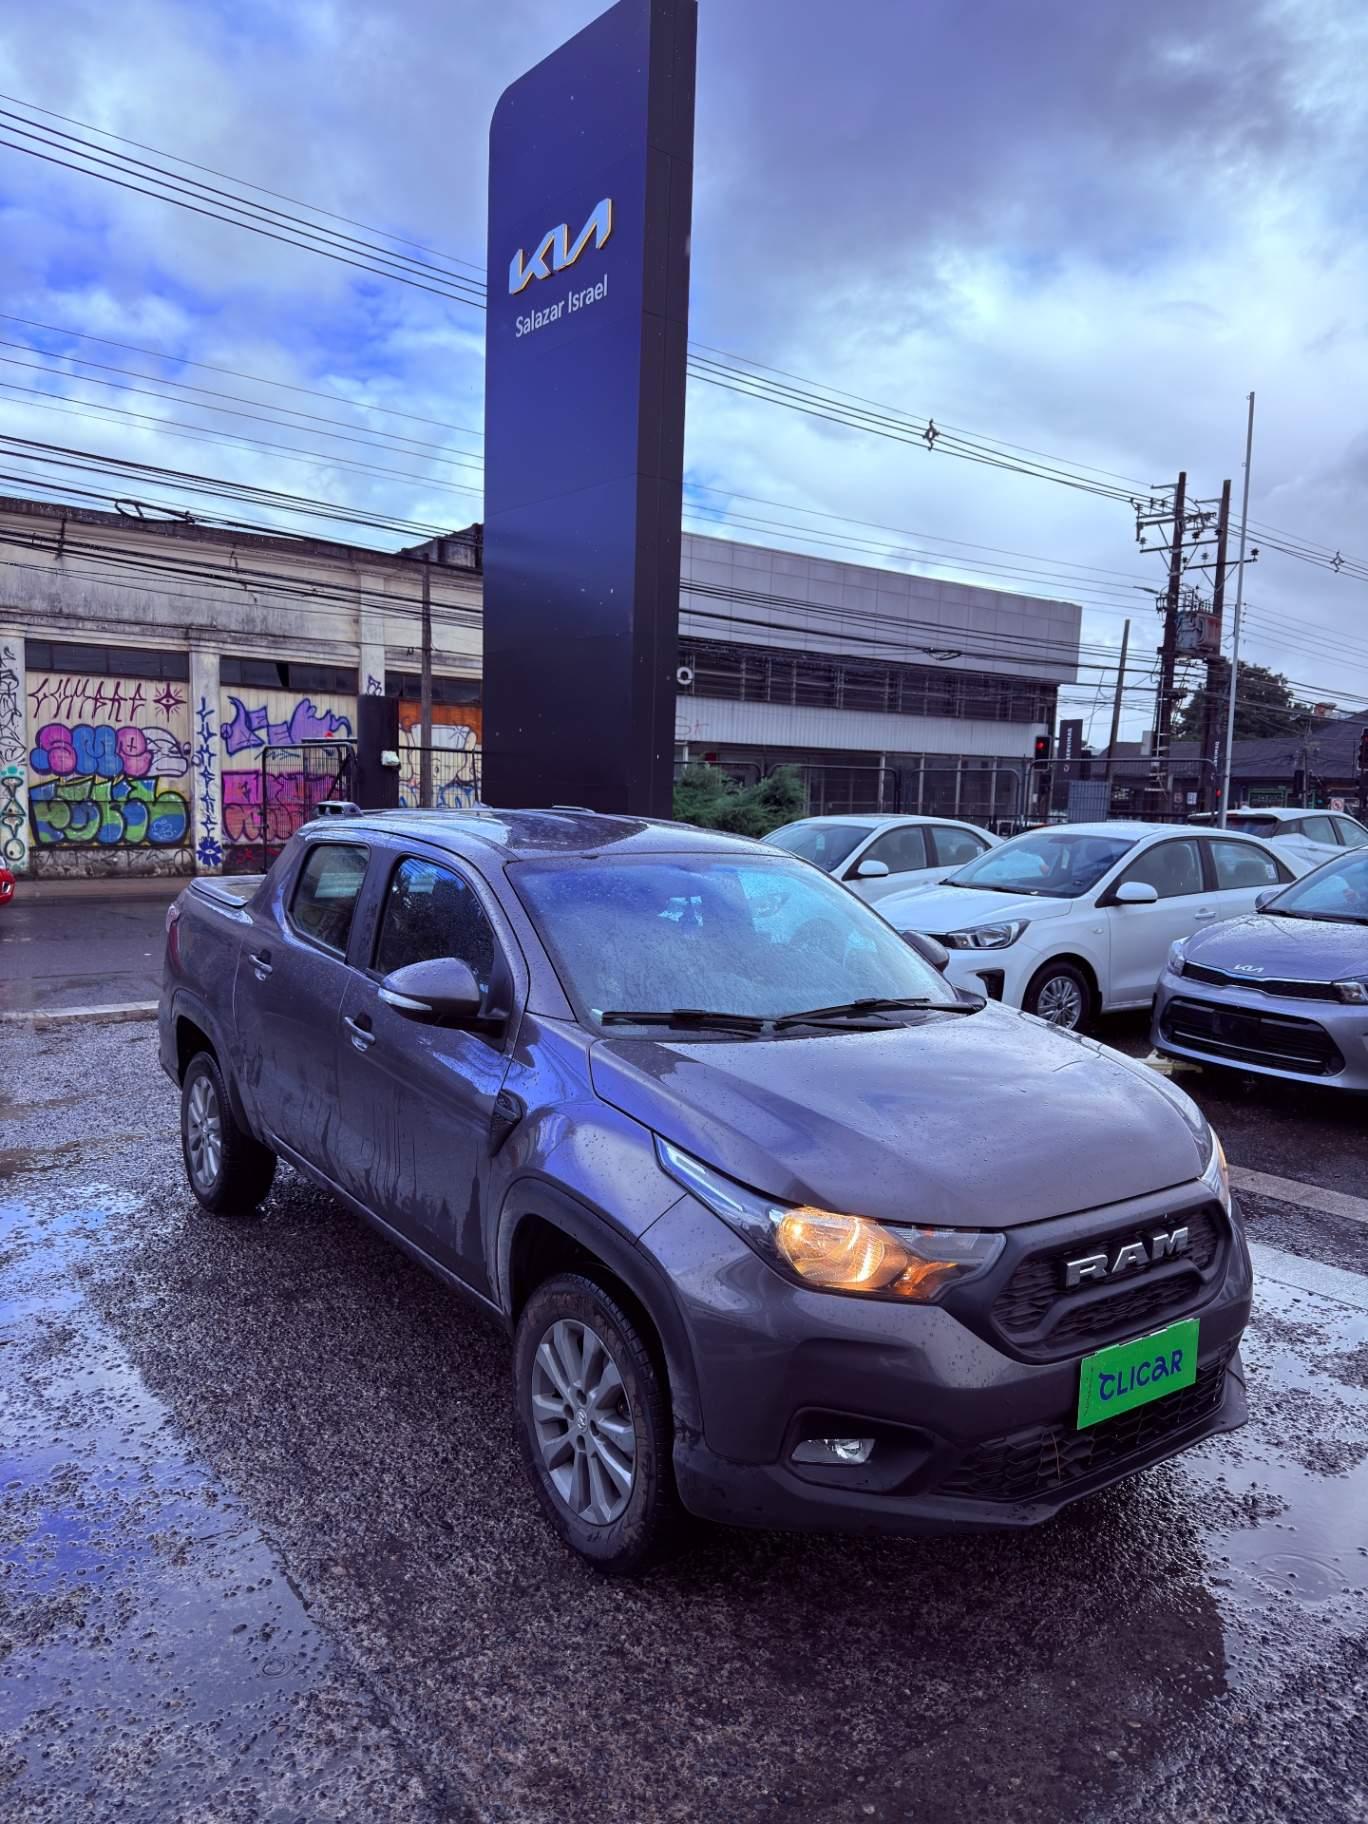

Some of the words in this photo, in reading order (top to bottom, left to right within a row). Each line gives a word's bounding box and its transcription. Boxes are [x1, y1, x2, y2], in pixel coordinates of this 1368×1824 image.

[509, 198, 612, 295] KIA
[515, 301, 565, 338] Salazar
[568, 273, 608, 313] Israel
[1065, 1226, 1188, 1289] RAM
